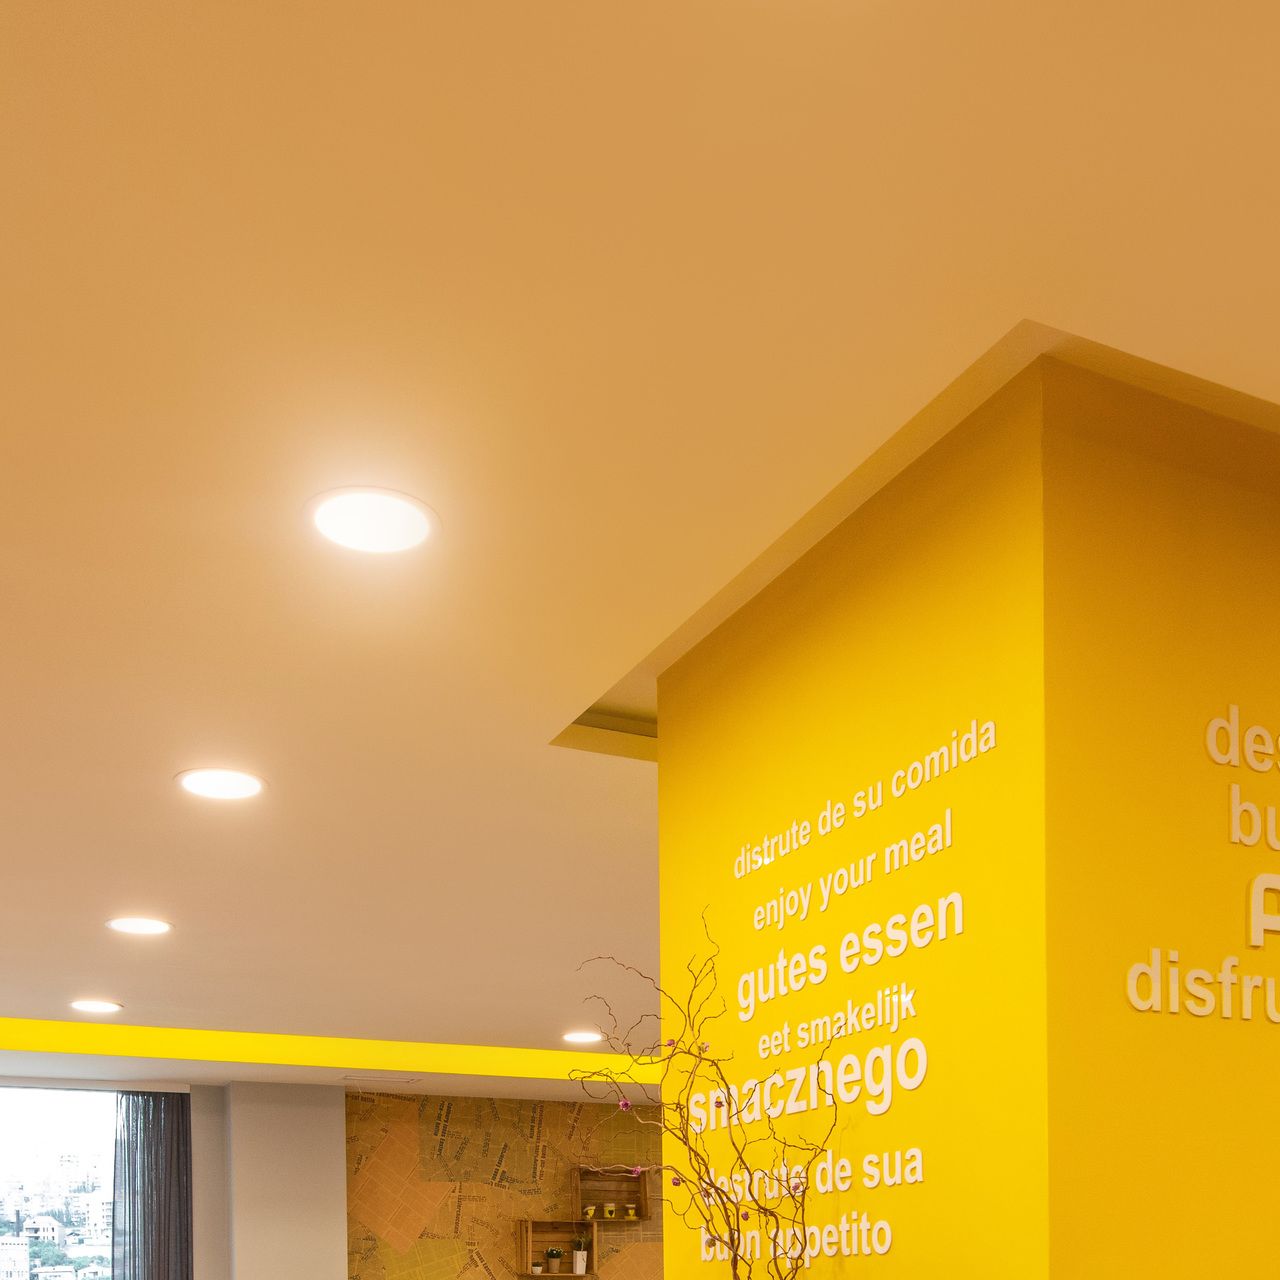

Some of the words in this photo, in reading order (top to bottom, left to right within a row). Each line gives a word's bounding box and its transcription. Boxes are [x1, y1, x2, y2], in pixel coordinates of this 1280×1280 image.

[817, 799, 847, 836] de
[852, 781, 884, 818] su
[890, 718, 997, 798] comida
[752, 882, 813, 931] enjoy
[818, 852, 878, 913] your
[884, 807, 953, 875] meal
[736, 943, 829, 1023] gutes
[838, 891, 964, 971] essen
[757, 1022, 792, 1060] eet
[796, 981, 917, 1049] smakelijk
[688, 1036, 929, 1135] smacznego
[814, 1148, 853, 1195] de
[862, 1146, 924, 1189] sua
[768, 1210, 893, 1269] appetito
